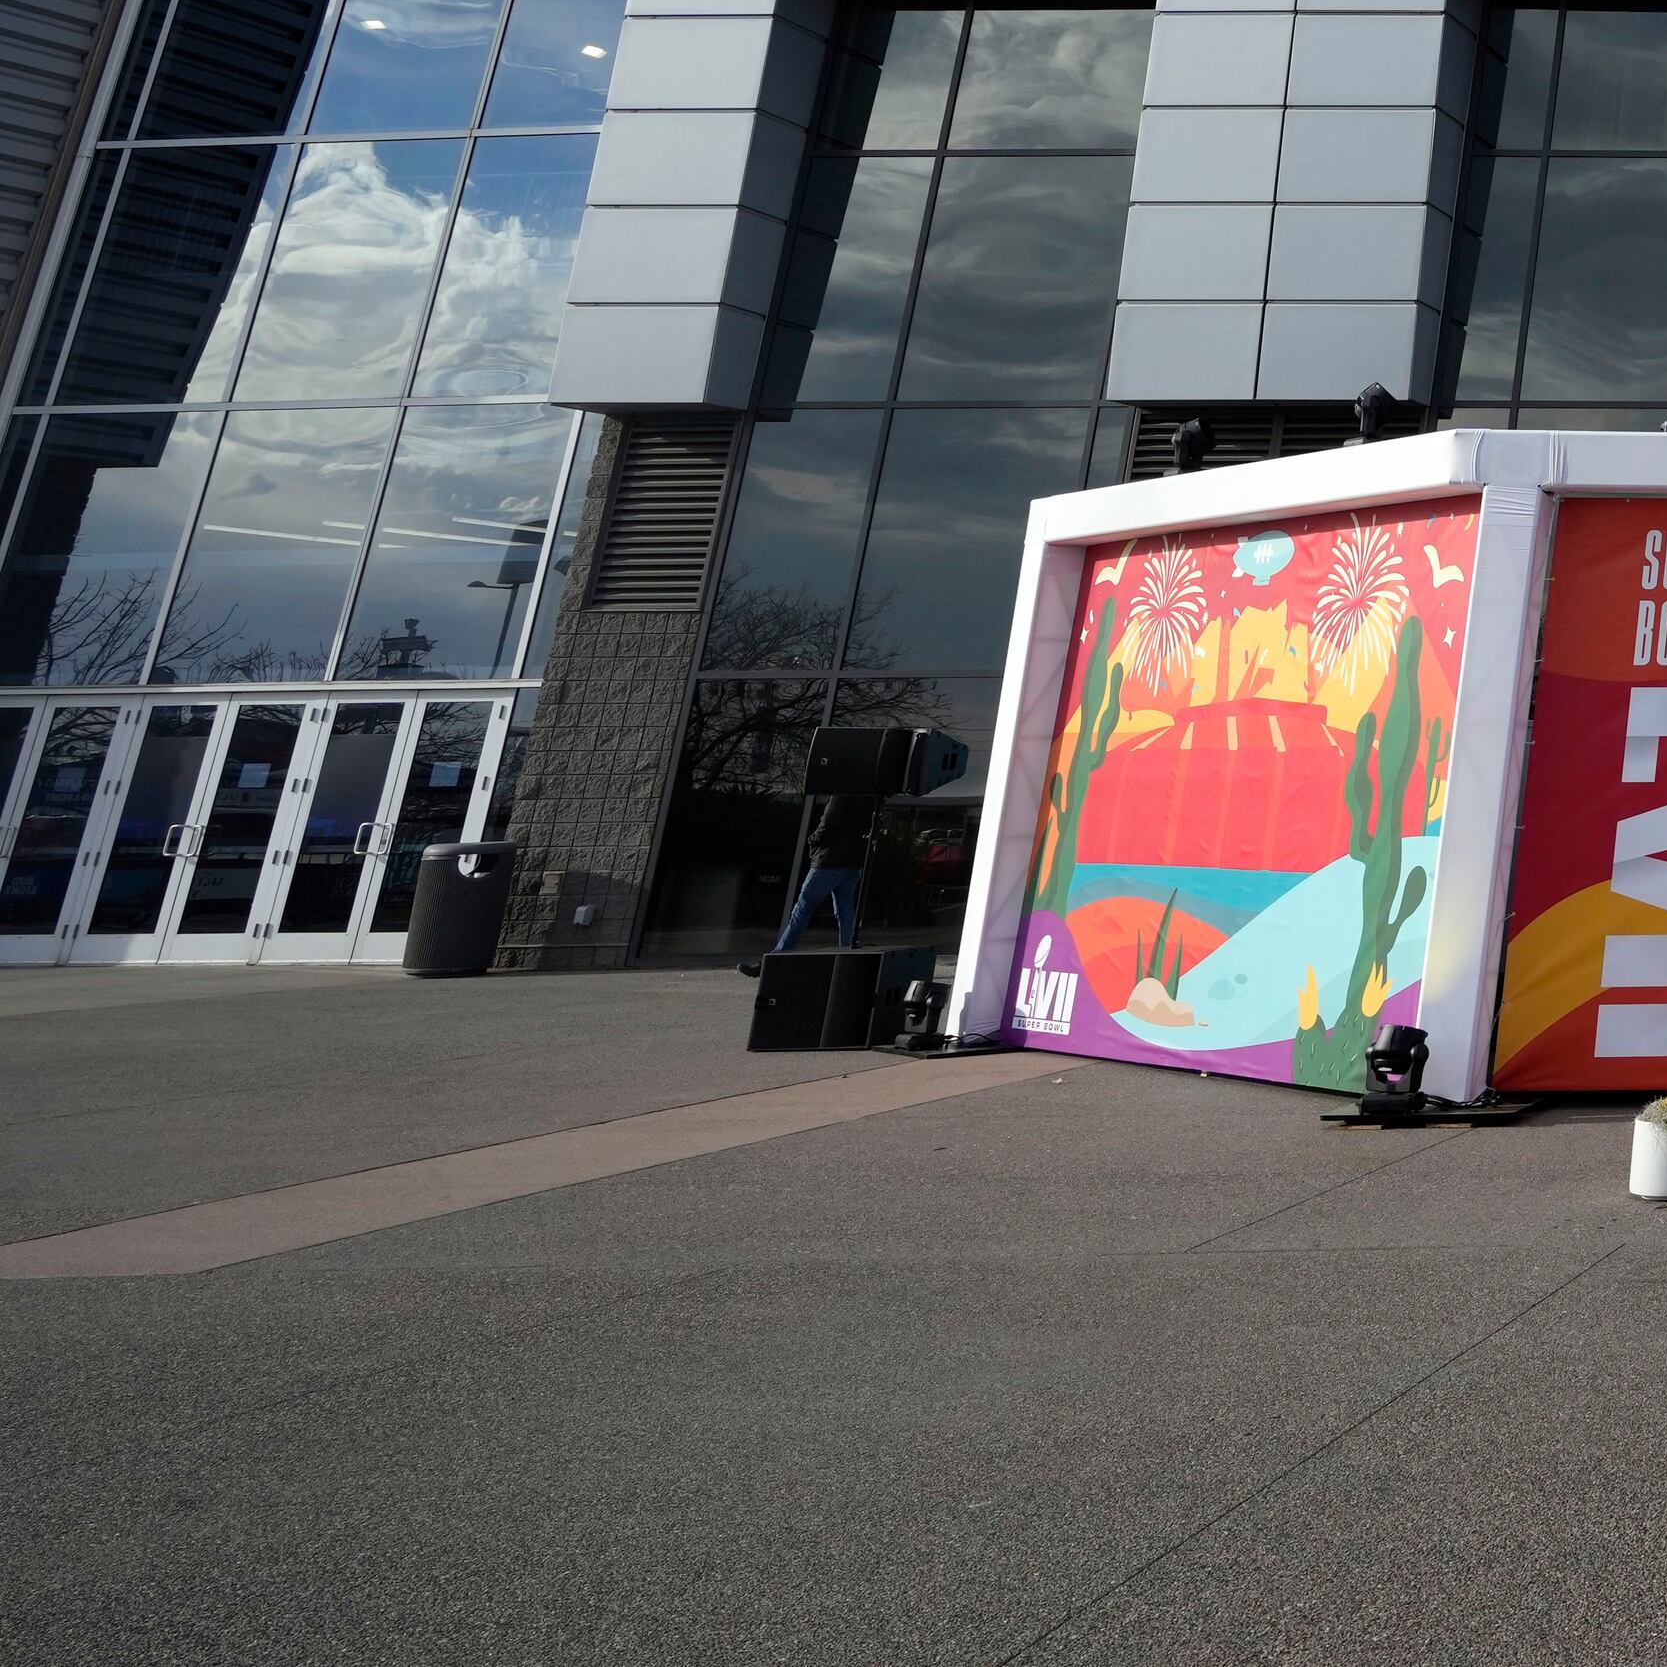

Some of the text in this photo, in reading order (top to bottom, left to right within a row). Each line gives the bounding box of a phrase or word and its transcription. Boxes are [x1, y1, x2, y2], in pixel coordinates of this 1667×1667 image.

[1015, 967, 1079, 1023] LVII
[1017, 1019, 1064, 1032] SUPER BOWL
